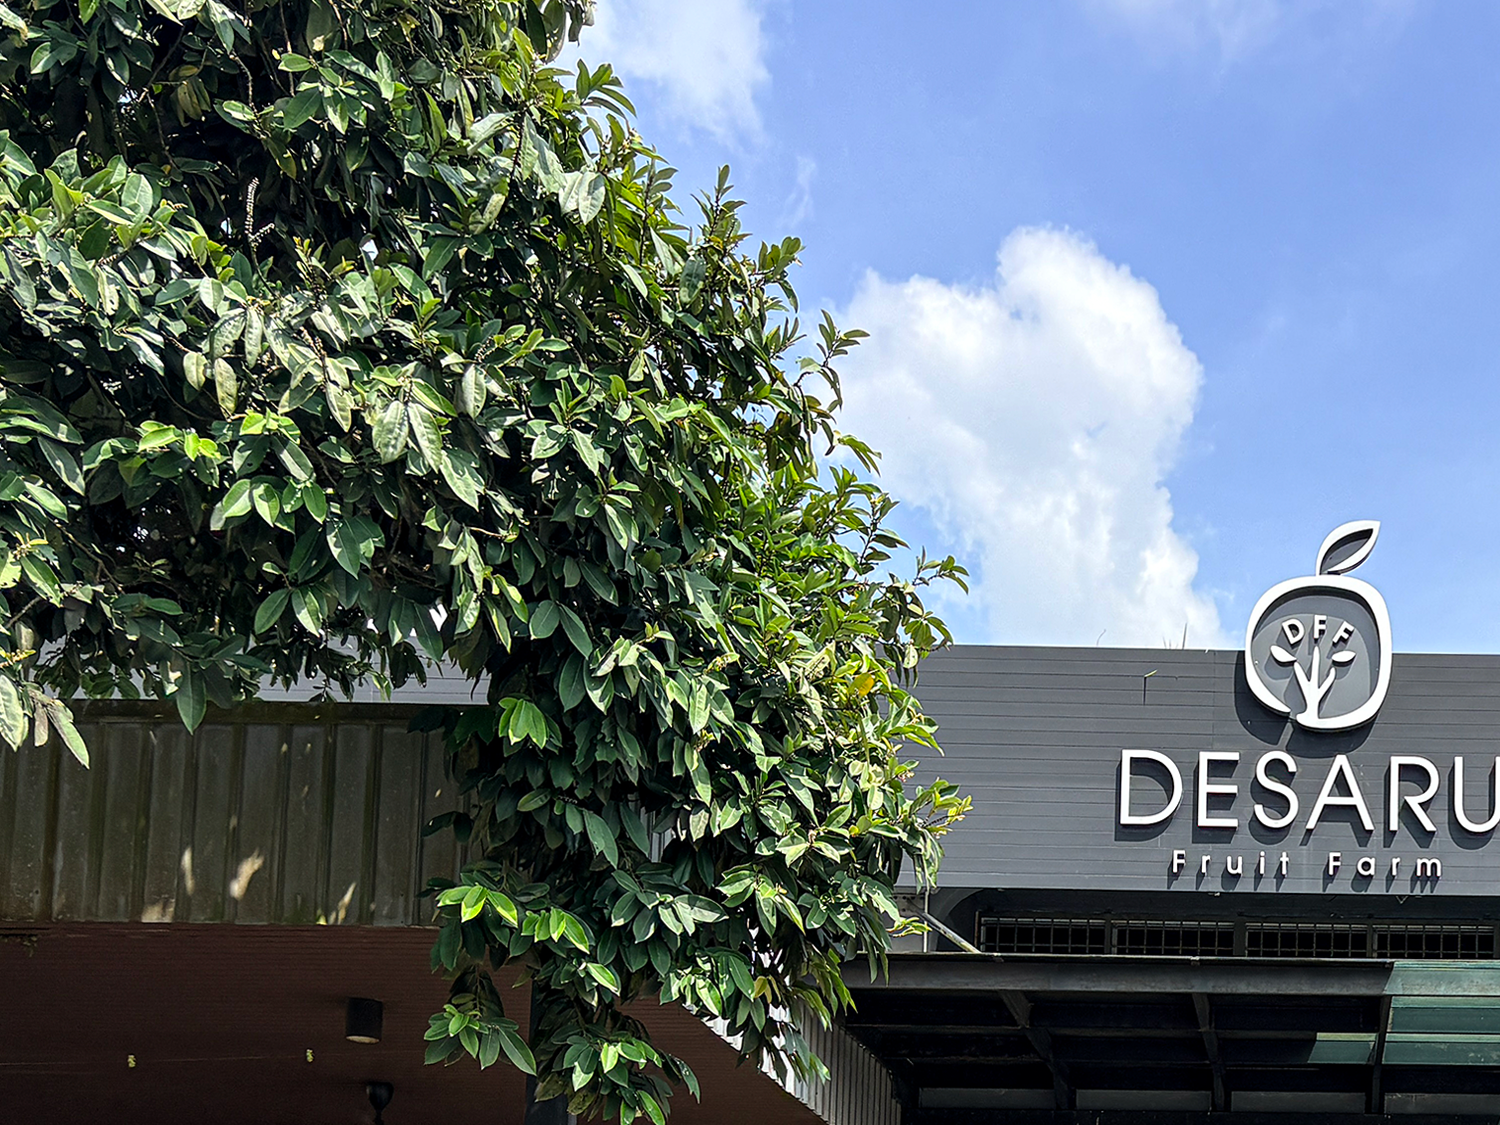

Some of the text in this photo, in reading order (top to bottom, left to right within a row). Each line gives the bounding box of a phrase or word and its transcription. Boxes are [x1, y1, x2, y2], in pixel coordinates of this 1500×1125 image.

[1282, 614, 1354, 645] DFF
[1172, 849, 1442, 877] Fruit Farm
